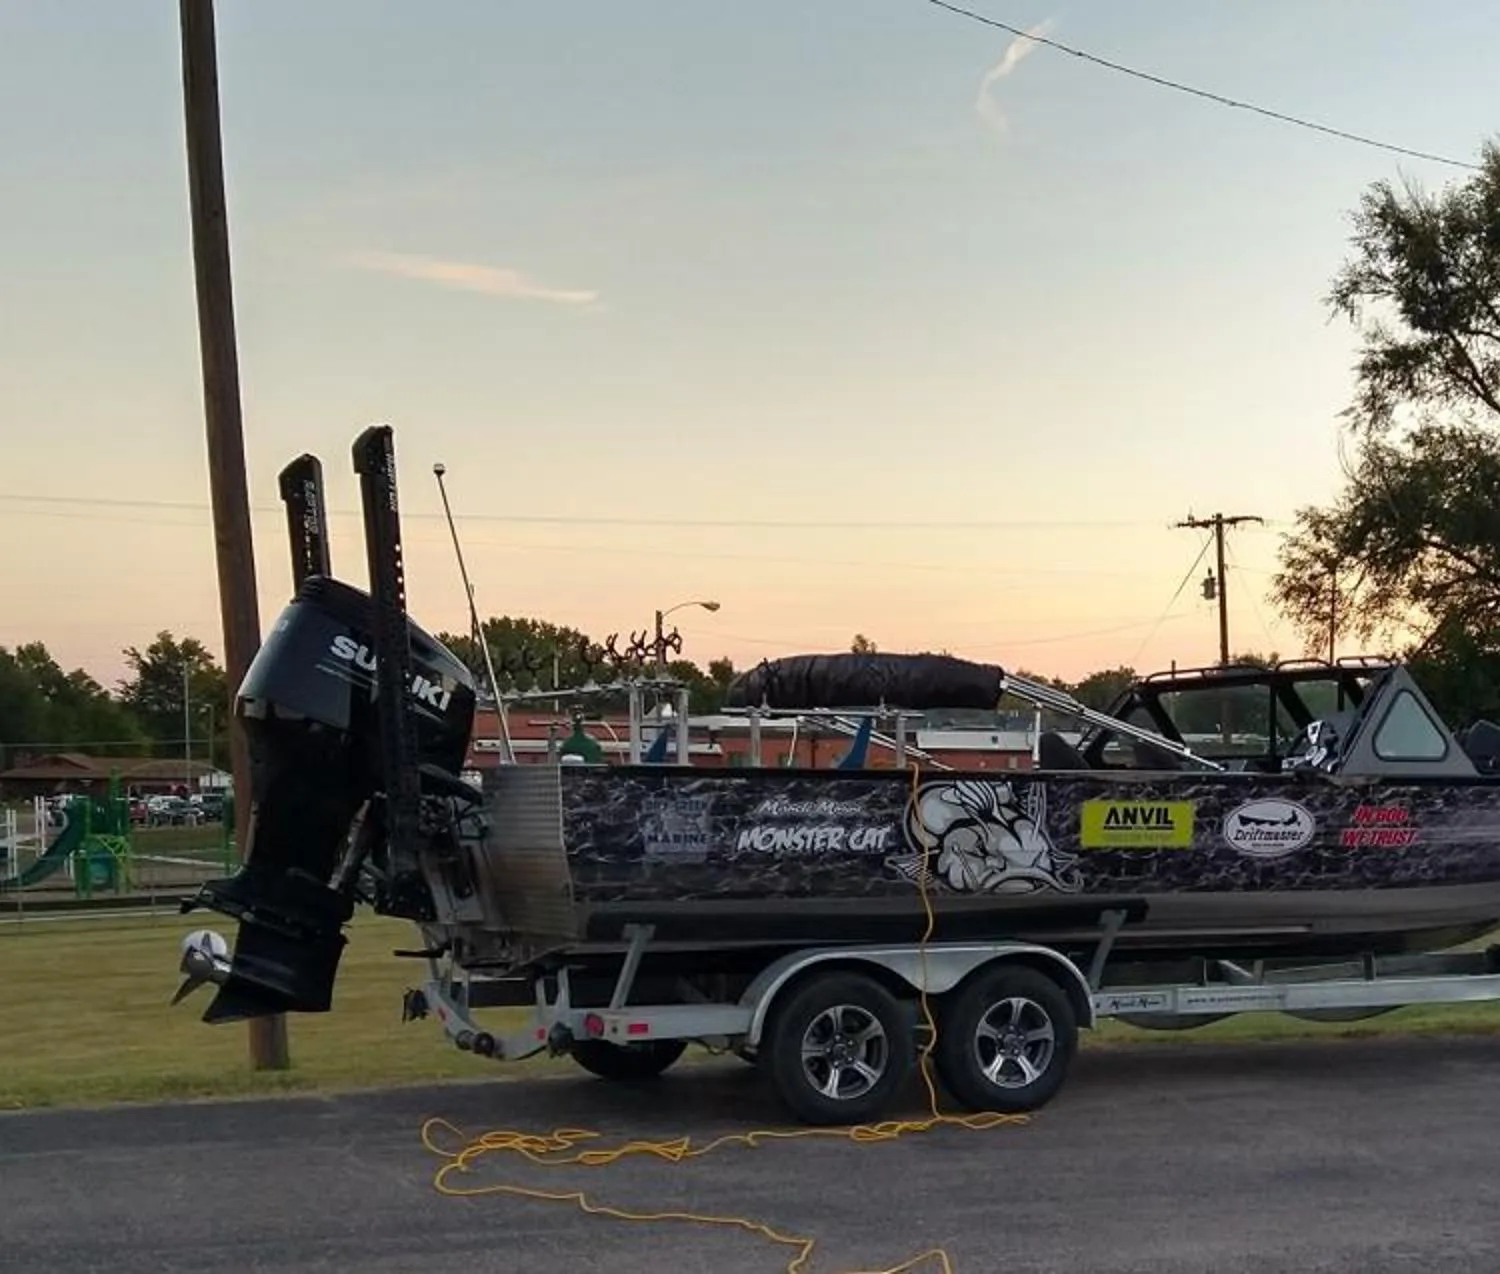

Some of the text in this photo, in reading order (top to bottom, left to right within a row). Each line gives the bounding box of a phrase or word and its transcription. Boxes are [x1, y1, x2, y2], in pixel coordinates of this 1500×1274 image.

[330, 635, 451, 711] SUKI
[1104, 807, 1174, 825] ANVIL
[737, 825, 891, 851] MONSTER CAT
[1371, 828, 1418, 847] TRUST
